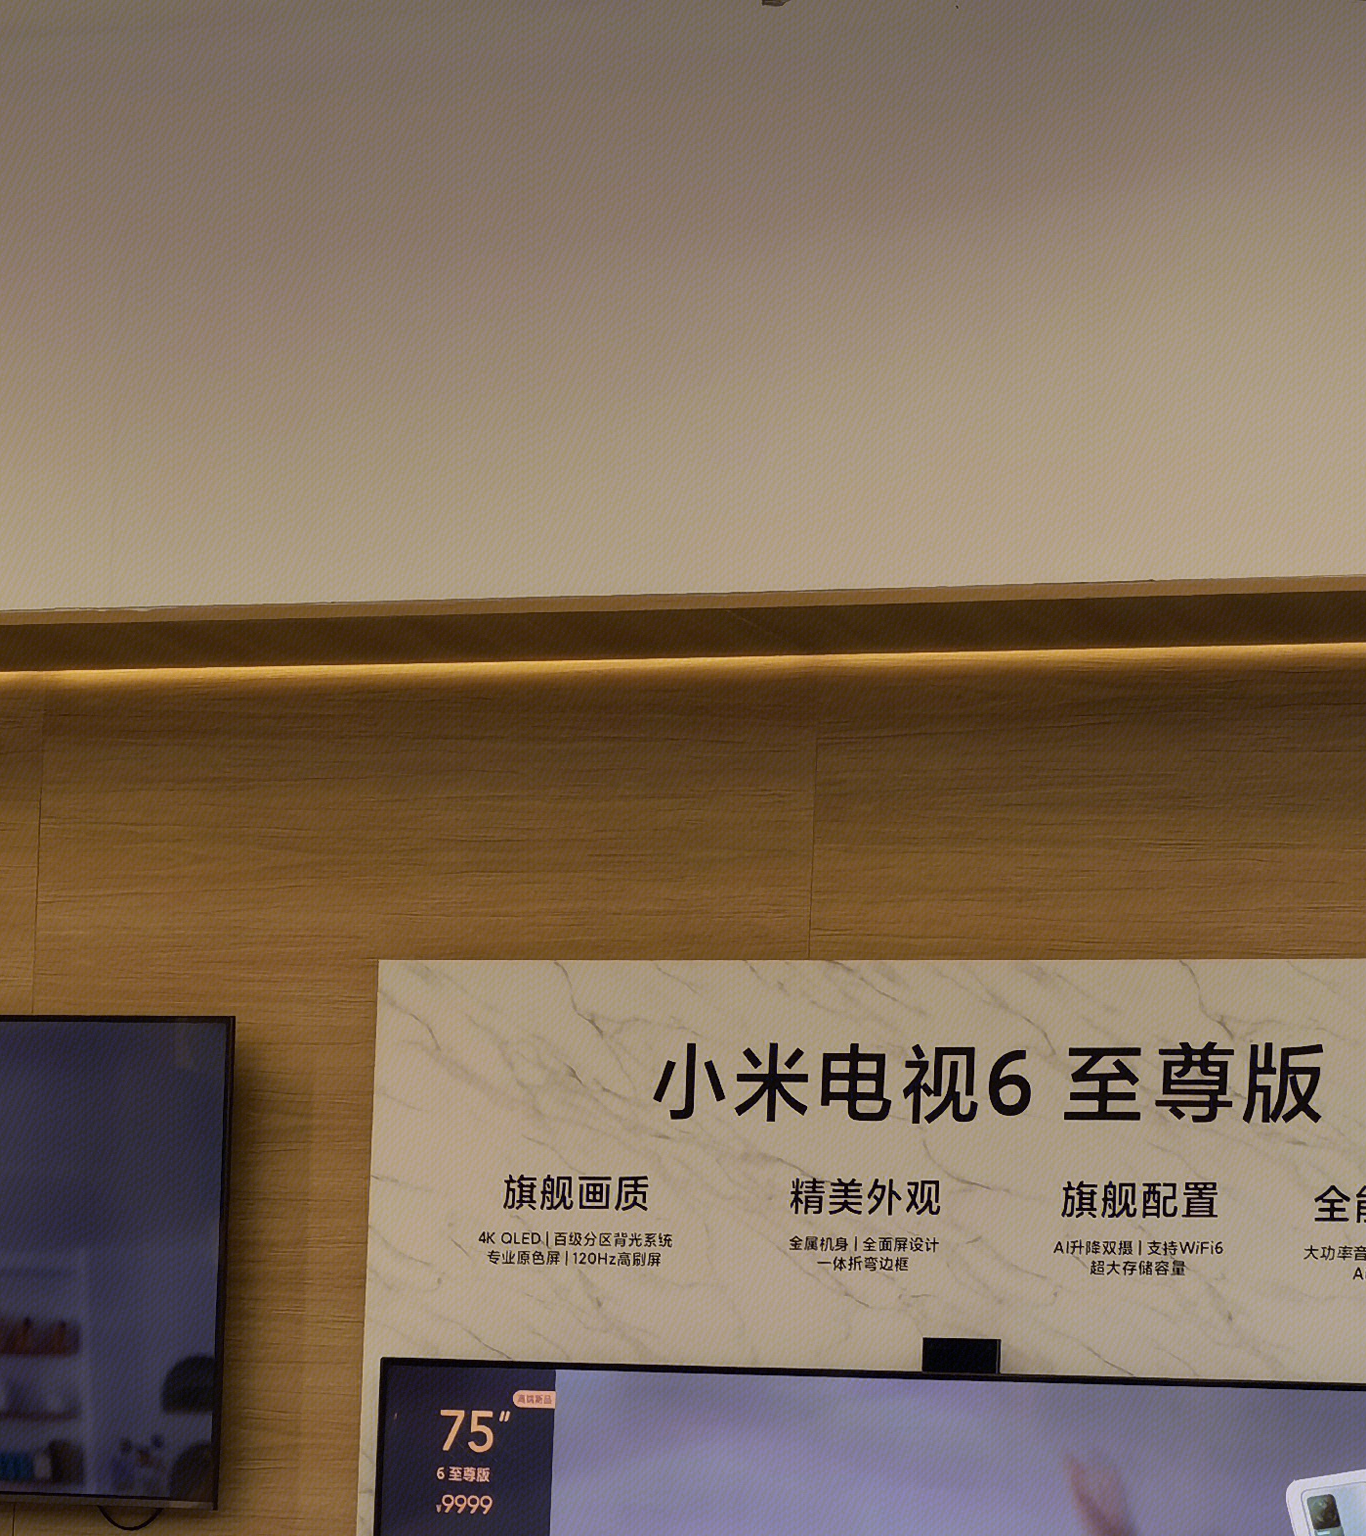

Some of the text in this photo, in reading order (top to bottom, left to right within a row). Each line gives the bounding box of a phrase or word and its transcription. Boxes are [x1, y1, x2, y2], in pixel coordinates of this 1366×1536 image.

[653, 1041, 1324, 1125] 小米电视6 至尊版
[502, 1173, 649, 1211] 旗舰画质
[789, 1177, 941, 1216] 精美外观
[1061, 1180, 1218, 1218] 旗舰配置
[478, 1231, 496, 1245] 4K
[501, 1231, 541, 1245] QLED
[436, 1466, 491, 1482] 6 至尊版
